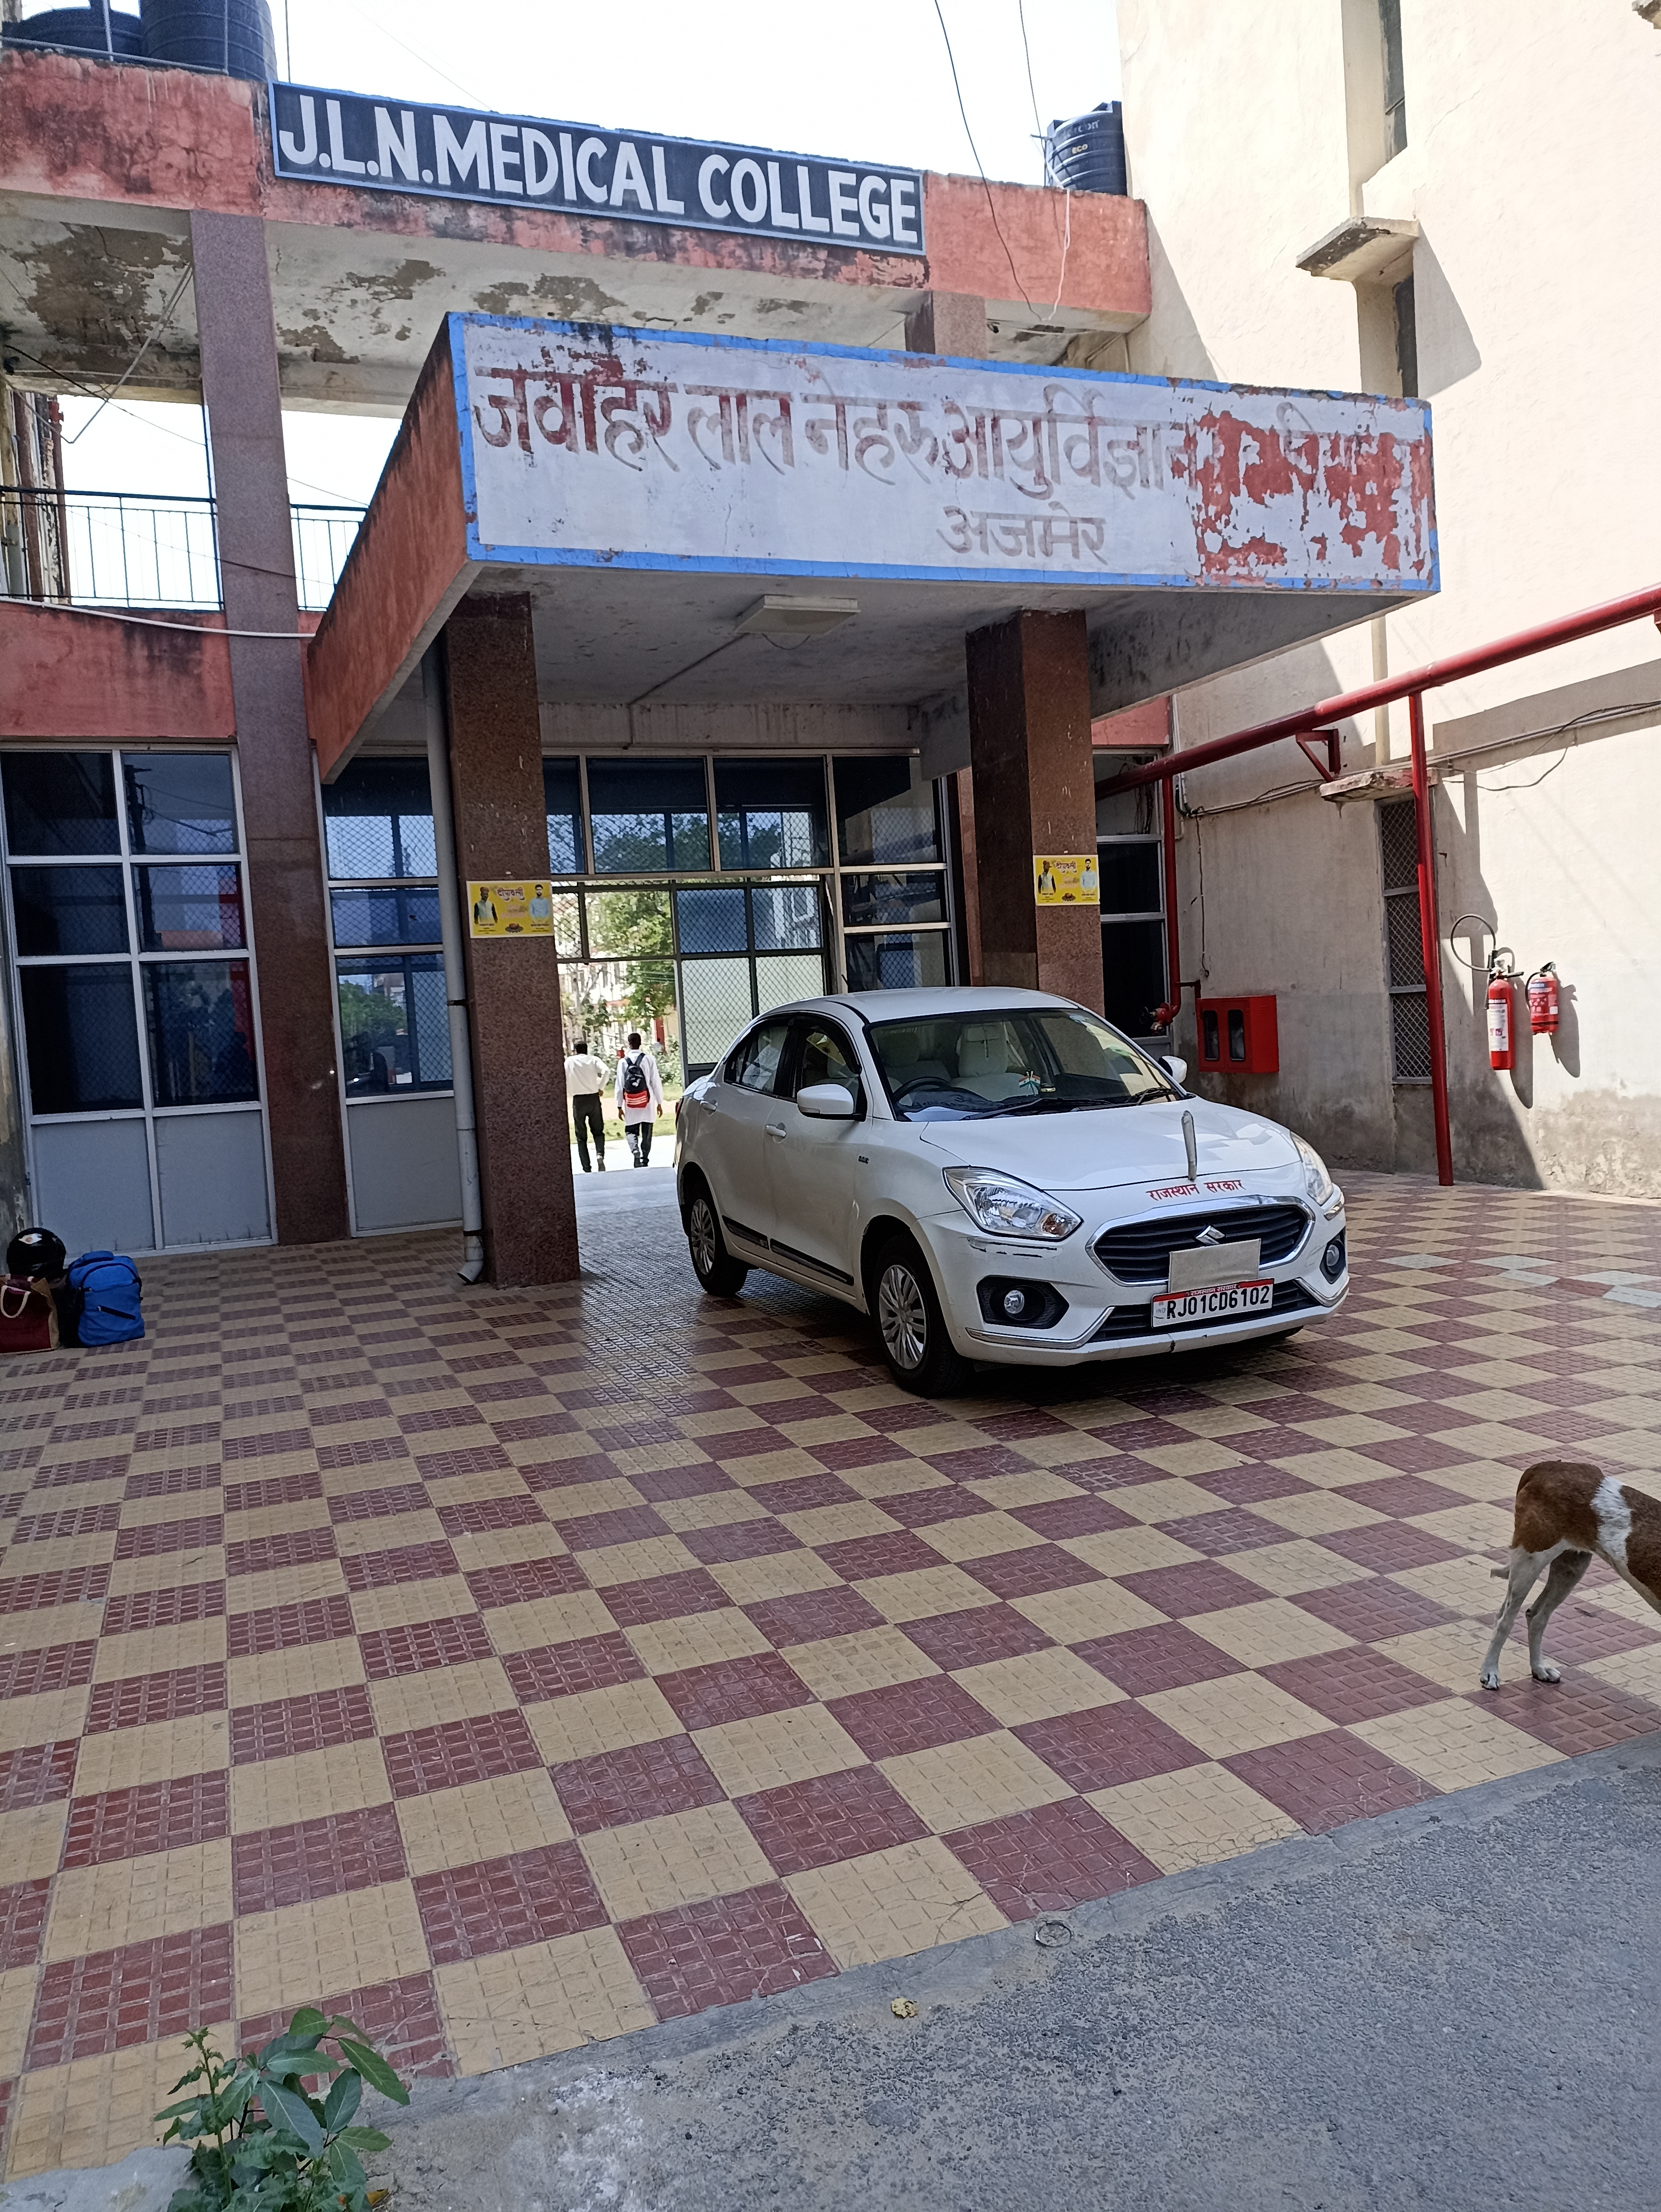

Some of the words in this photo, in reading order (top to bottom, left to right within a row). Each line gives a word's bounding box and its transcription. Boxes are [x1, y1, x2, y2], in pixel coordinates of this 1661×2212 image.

[698, 154, 919, 243] COLLEGE
[683, 383, 795, 475] लाल
[936, 501, 1107, 564] अजमेर
[1146, 1183, 1200, 1201] राजस्थान
[1204, 1180, 1247, 1193] सरकार
[1166, 1285, 1270, 1319] RJ01CD6102
[1190, 1287, 1216, 1296] राजस्थान
